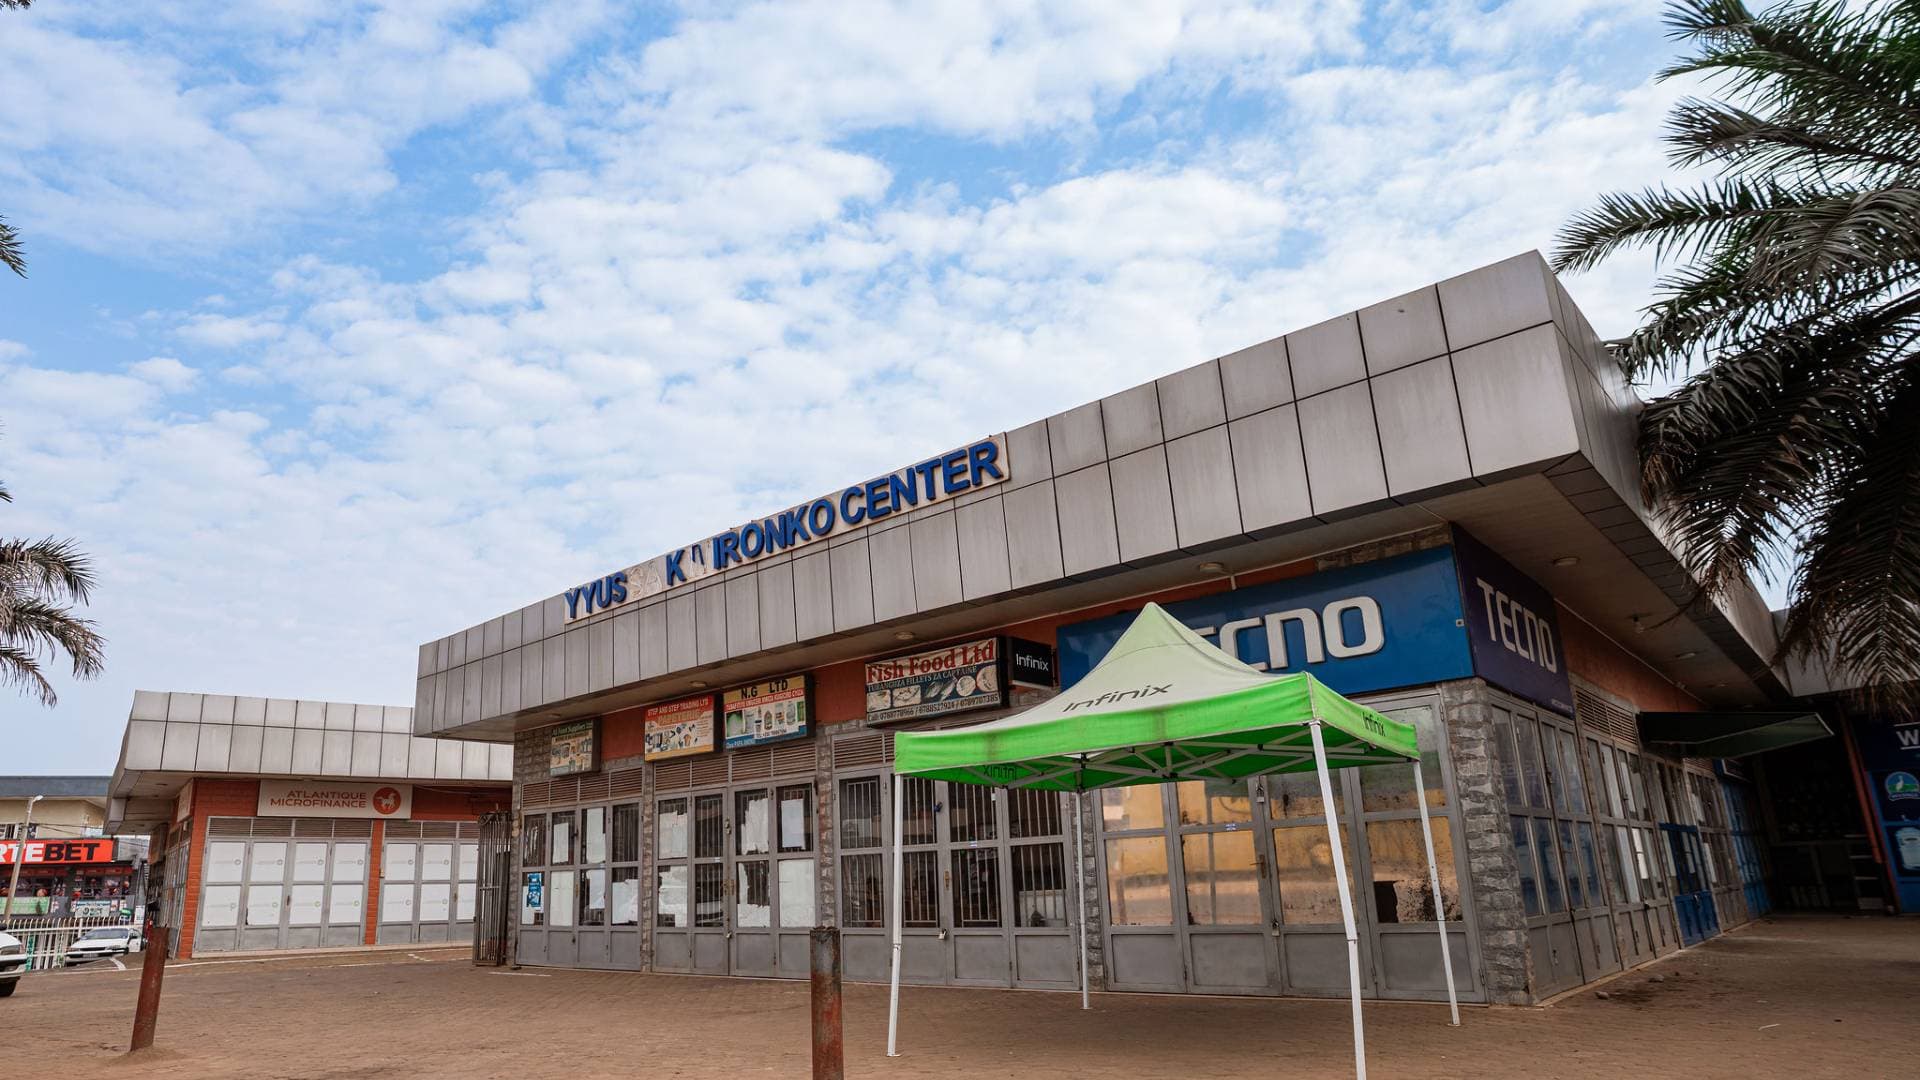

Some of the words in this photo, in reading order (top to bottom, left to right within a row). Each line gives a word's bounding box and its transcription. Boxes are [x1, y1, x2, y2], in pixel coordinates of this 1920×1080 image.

[840, 440, 1004, 525] CENTER
[1476, 576, 1557, 673] TECNO
[867, 659, 904, 684] Fish
[909, 649, 956, 677] Food
[961, 639, 994, 665] Ltd
[1016, 653, 1049, 673] Infinix
[741, 686, 758, 699] N.G
[769, 679, 788, 693] LTD
[1062, 684, 1173, 712] Infinix
[270, 797, 367, 808] MICROFINANCE
[286, 789, 367, 800] ATLANTIQUE
